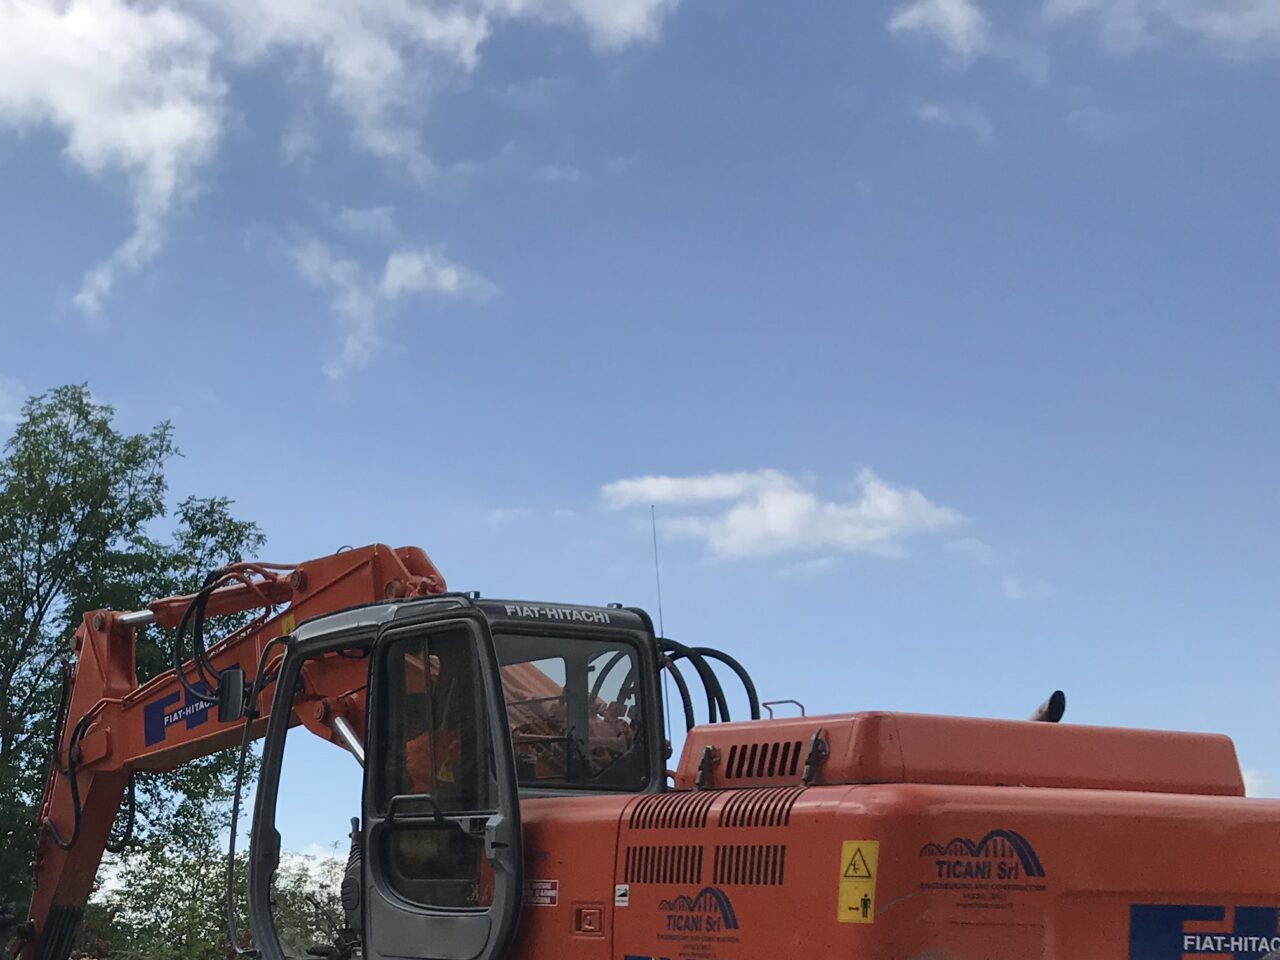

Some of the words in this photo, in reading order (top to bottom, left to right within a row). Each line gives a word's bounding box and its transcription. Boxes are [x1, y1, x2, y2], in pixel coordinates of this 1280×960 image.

[504, 604, 611, 624] FIAT-HITACHI
[936, 860, 992, 879] TICANI
[997, 861, 1019, 880] Srl
[666, 914, 703, 933] TICANI
